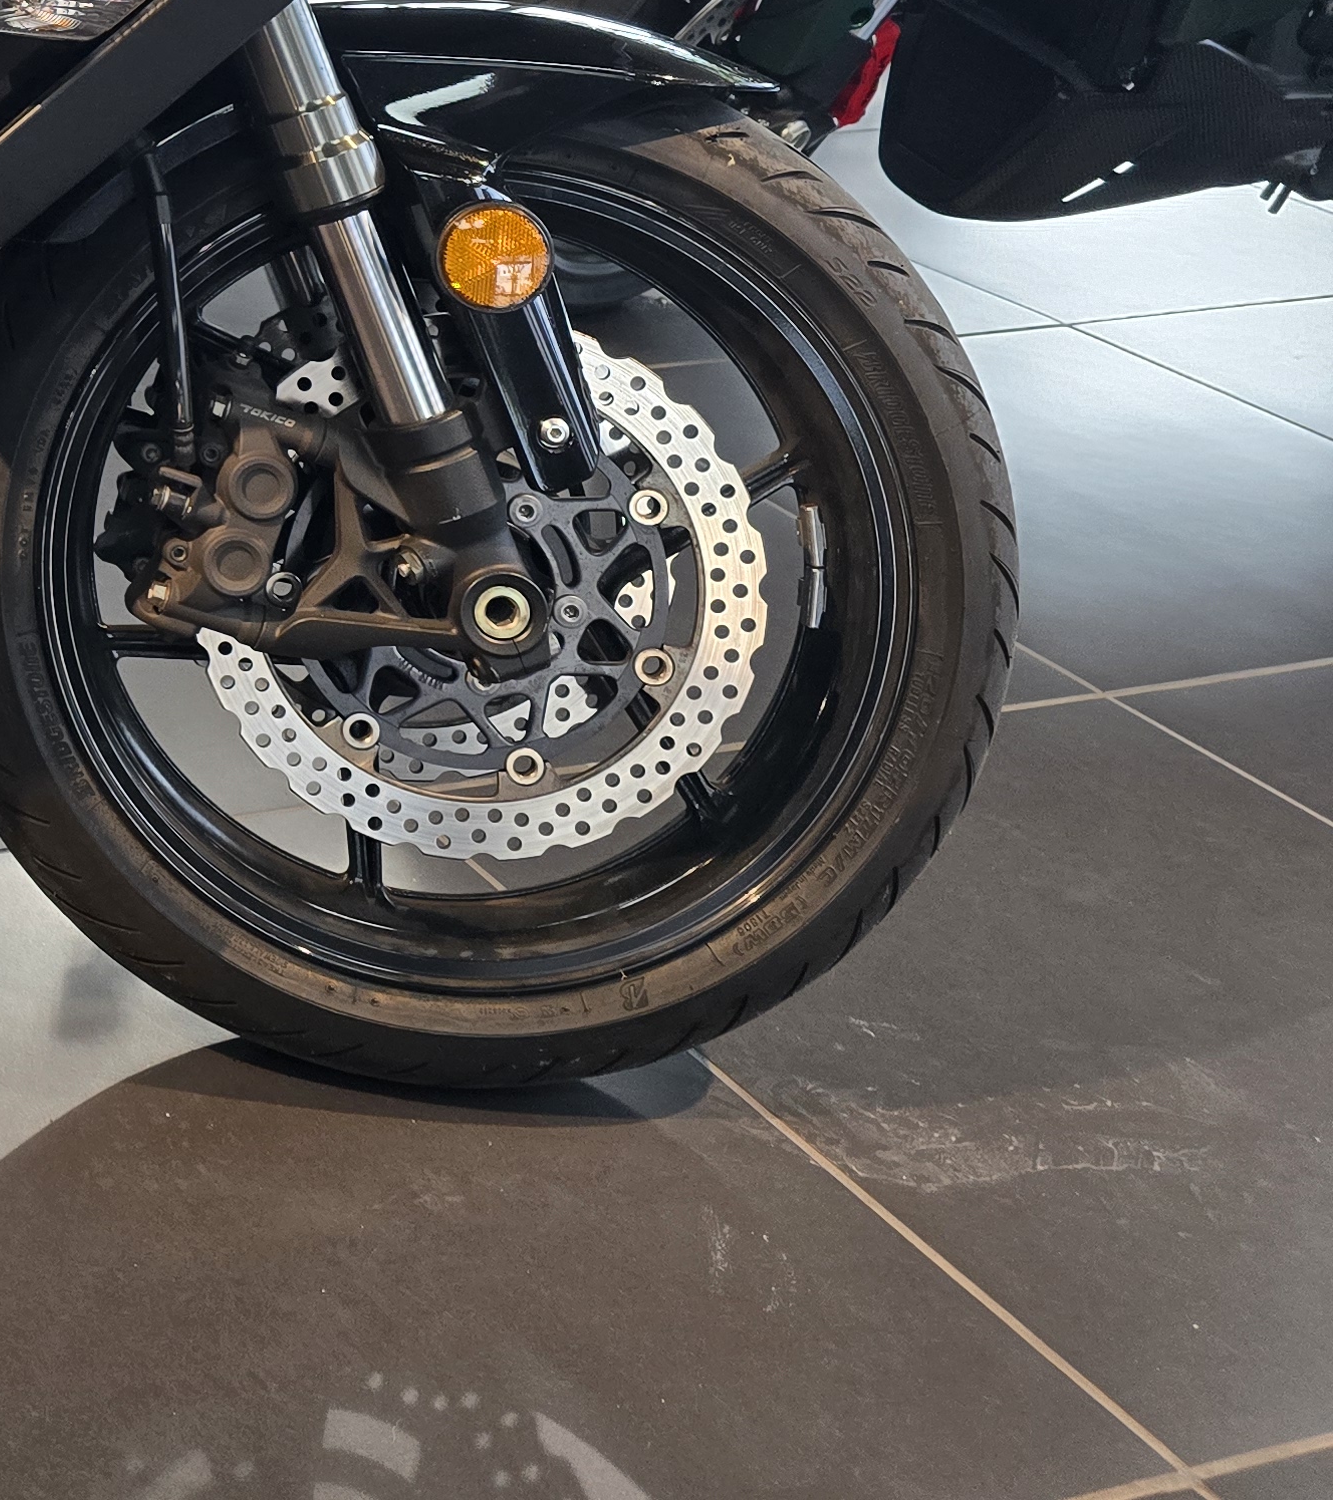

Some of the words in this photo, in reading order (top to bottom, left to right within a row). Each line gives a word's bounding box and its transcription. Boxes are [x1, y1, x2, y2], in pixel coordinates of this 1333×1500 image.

[825, 255, 879, 310] S22
[239, 403, 296, 428] TOKICO
[18, 640, 96, 803] BRIDGESTONE
